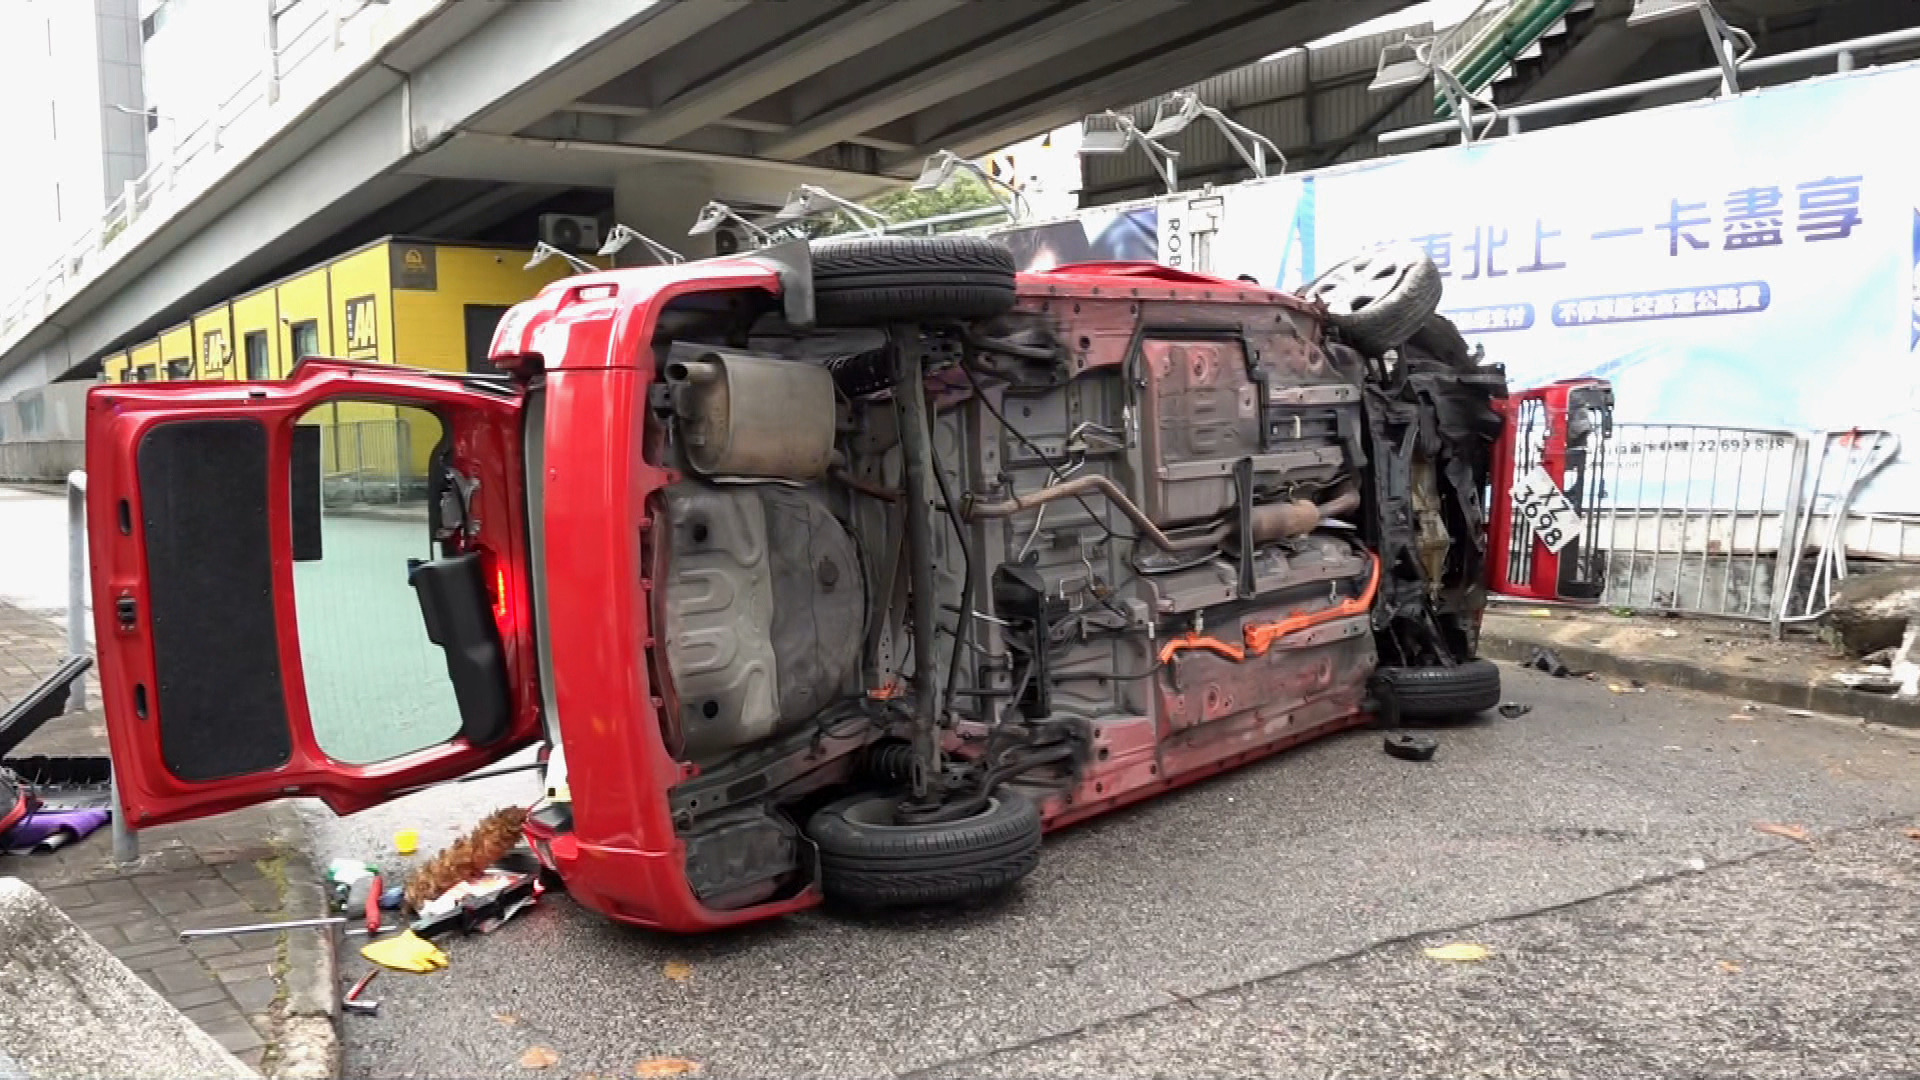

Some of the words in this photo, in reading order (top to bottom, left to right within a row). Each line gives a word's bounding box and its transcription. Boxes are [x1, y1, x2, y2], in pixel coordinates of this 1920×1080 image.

[1592, 176, 1863, 256] 一卡盡享
[1514, 485, 1562, 546] 3698
[1539, 486, 1570, 521] XZ
